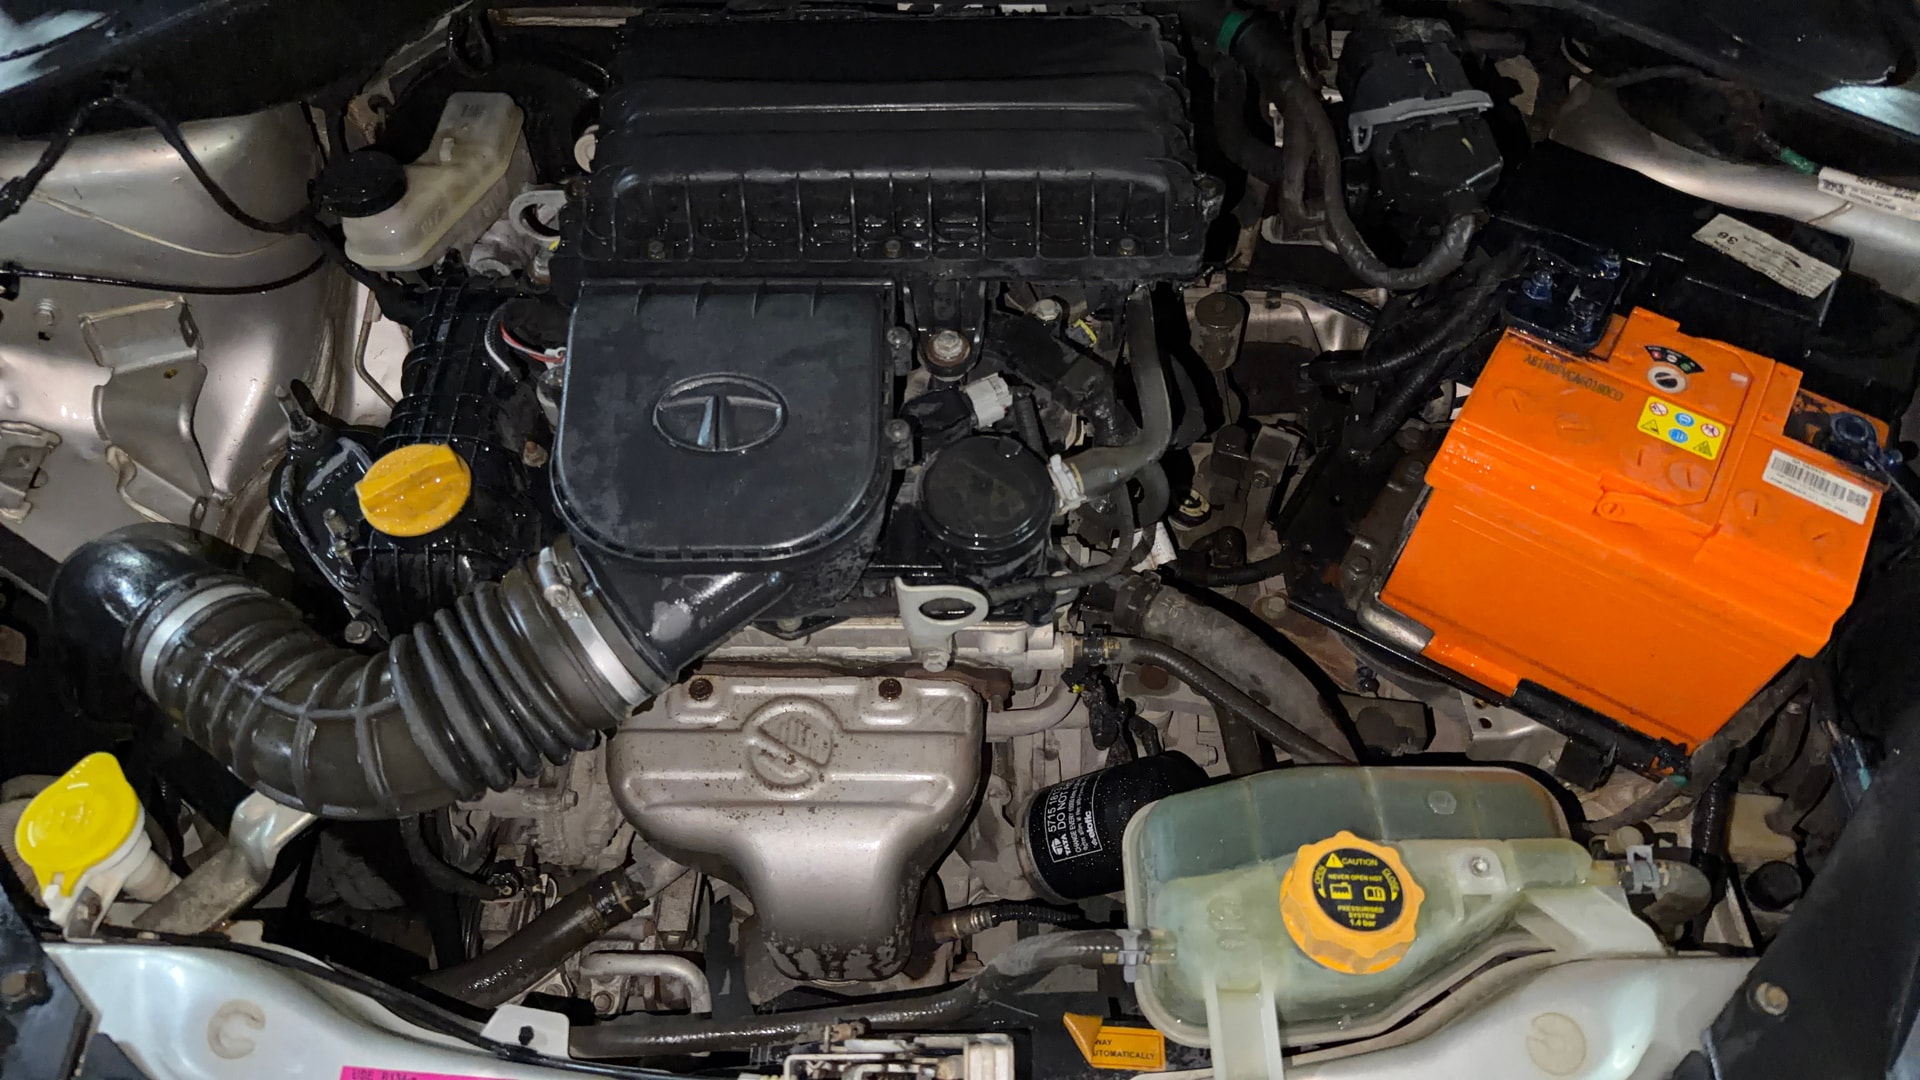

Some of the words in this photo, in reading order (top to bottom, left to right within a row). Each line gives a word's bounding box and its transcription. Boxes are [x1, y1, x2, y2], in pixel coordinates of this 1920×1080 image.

[1057, 791, 1068, 811] NOT
[1047, 807, 1057, 832] 5715
[1057, 812, 1066, 830] DO
[1061, 833, 1071, 856] TATA
[1341, 858, 1378, 866] CAUTION
[1314, 865, 1327, 884] OPEN
[1369, 875, 1383, 883] HOT
[1382, 868, 1400, 892] CLOSE
[1348, 911, 1376, 919] SYSTEM
[1350, 918, 1361, 927] 1.4
[1362, 919, 1377, 928] bar
[1093, 1050, 1154, 1059] UTOMATICALLY
